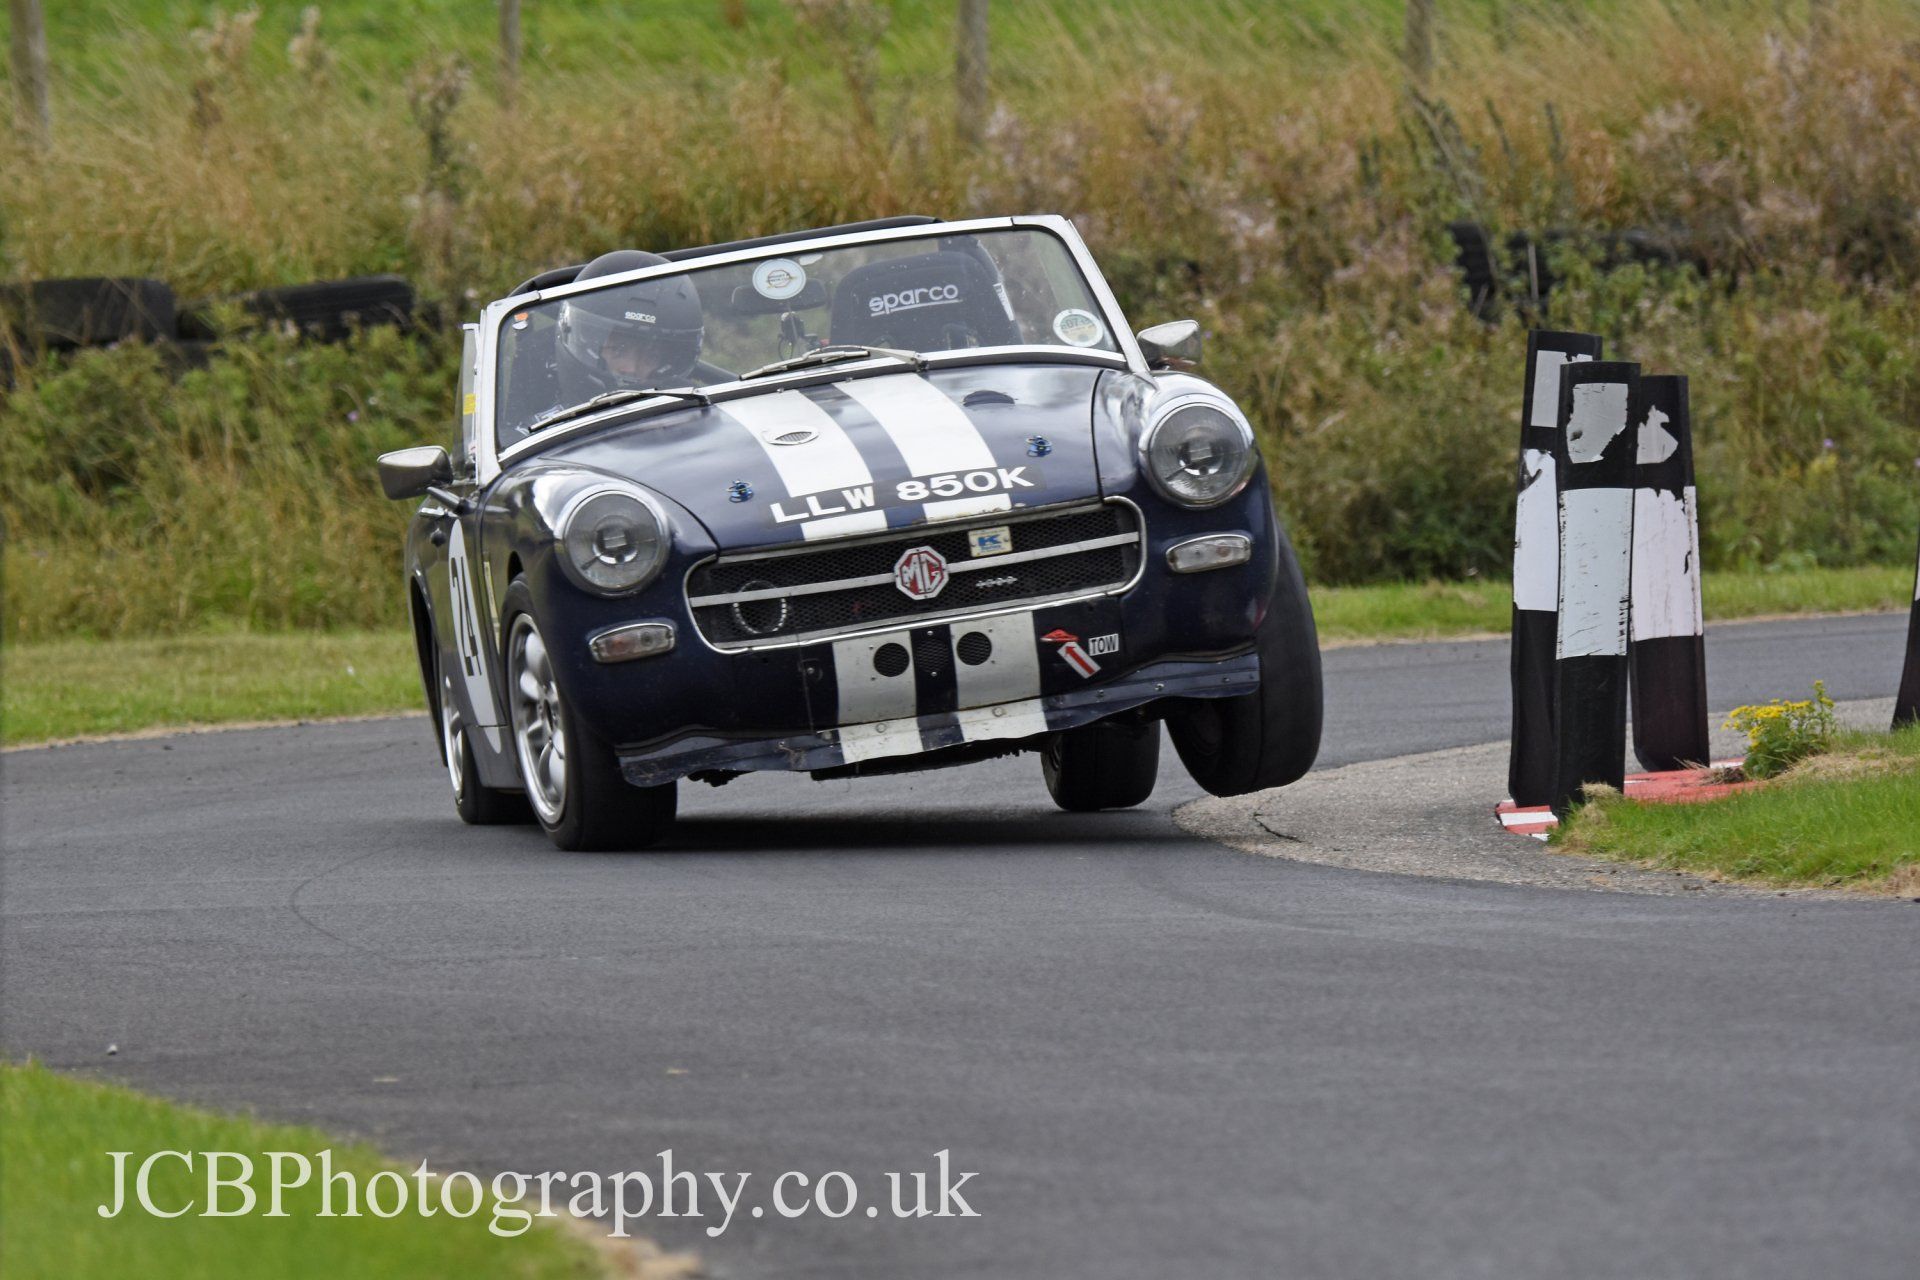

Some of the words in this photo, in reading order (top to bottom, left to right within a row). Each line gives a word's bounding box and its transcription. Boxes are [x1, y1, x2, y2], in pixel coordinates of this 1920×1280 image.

[868, 284, 959, 315] sparco
[769, 485, 875, 524] LLW
[895, 466, 1035, 501] 850K
[899, 550, 944, 596] MG
[450, 556, 482, 677] 24
[1090, 633, 1118, 655] TOW
